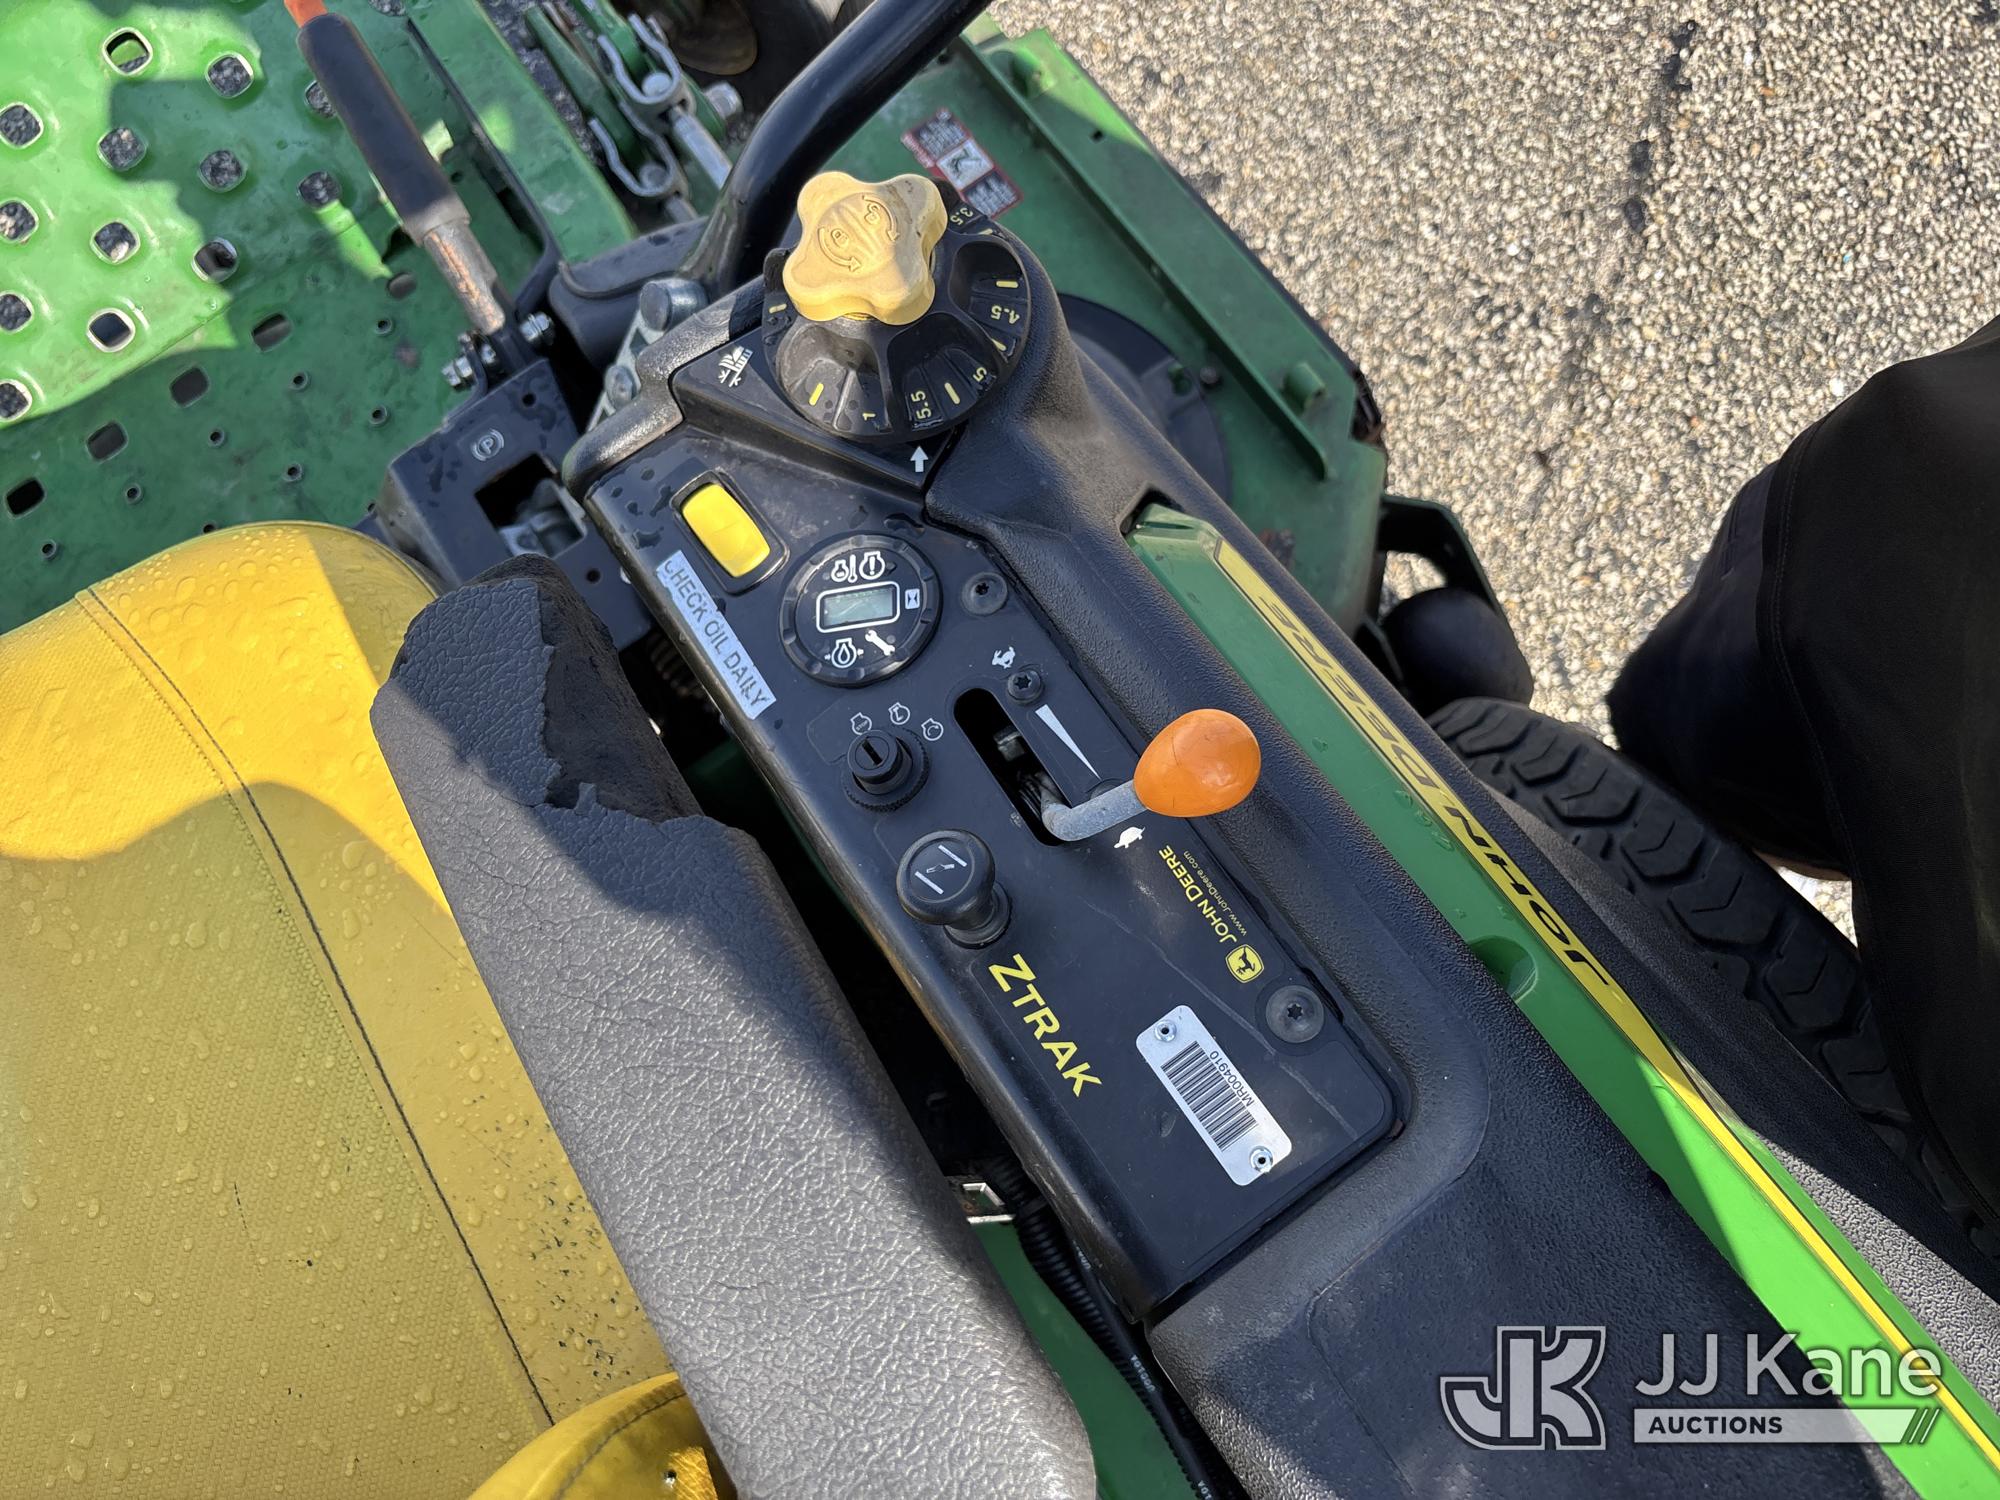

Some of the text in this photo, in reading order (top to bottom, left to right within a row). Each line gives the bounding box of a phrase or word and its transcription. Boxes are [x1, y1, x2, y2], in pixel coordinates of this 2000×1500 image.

[950, 206, 974, 226] 3.5
[990, 305, 1021, 325] 4.5
[910, 390, 933, 420] 5.5
[972, 366, 988, 382] 5
[664, 560, 769, 707] CHECK OIL DAILY
[1257, 594, 1611, 987] JOHN DEERE
[1158, 844, 1238, 943] JOHN DEERE
[1183, 850, 1247, 936] www.JohnDeere.com
[988, 953, 1103, 1098] ZTRAK
[1209, 1050, 1255, 1107] MR004910
